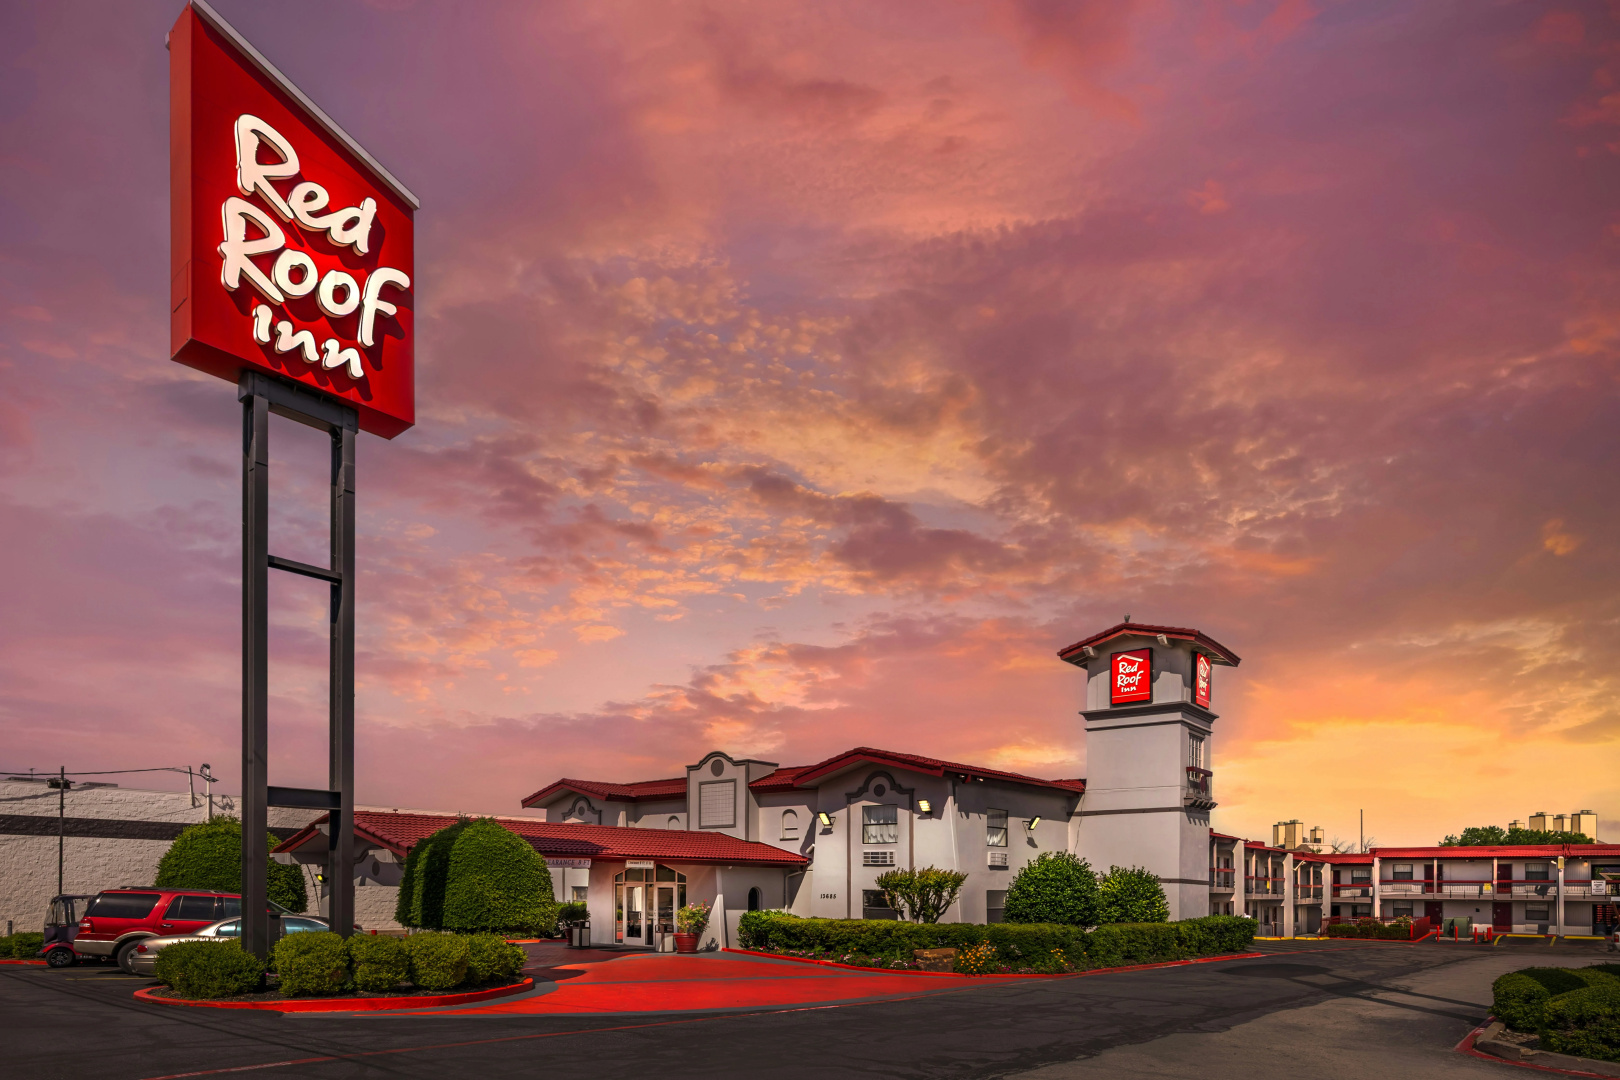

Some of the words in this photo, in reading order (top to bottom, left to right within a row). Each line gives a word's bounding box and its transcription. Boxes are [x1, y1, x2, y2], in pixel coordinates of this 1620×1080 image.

[234, 113, 377, 256] Red
[217, 196, 411, 348] Roof
[1117, 670, 1144, 688] Roof
[1118, 661, 1139, 674] Red
